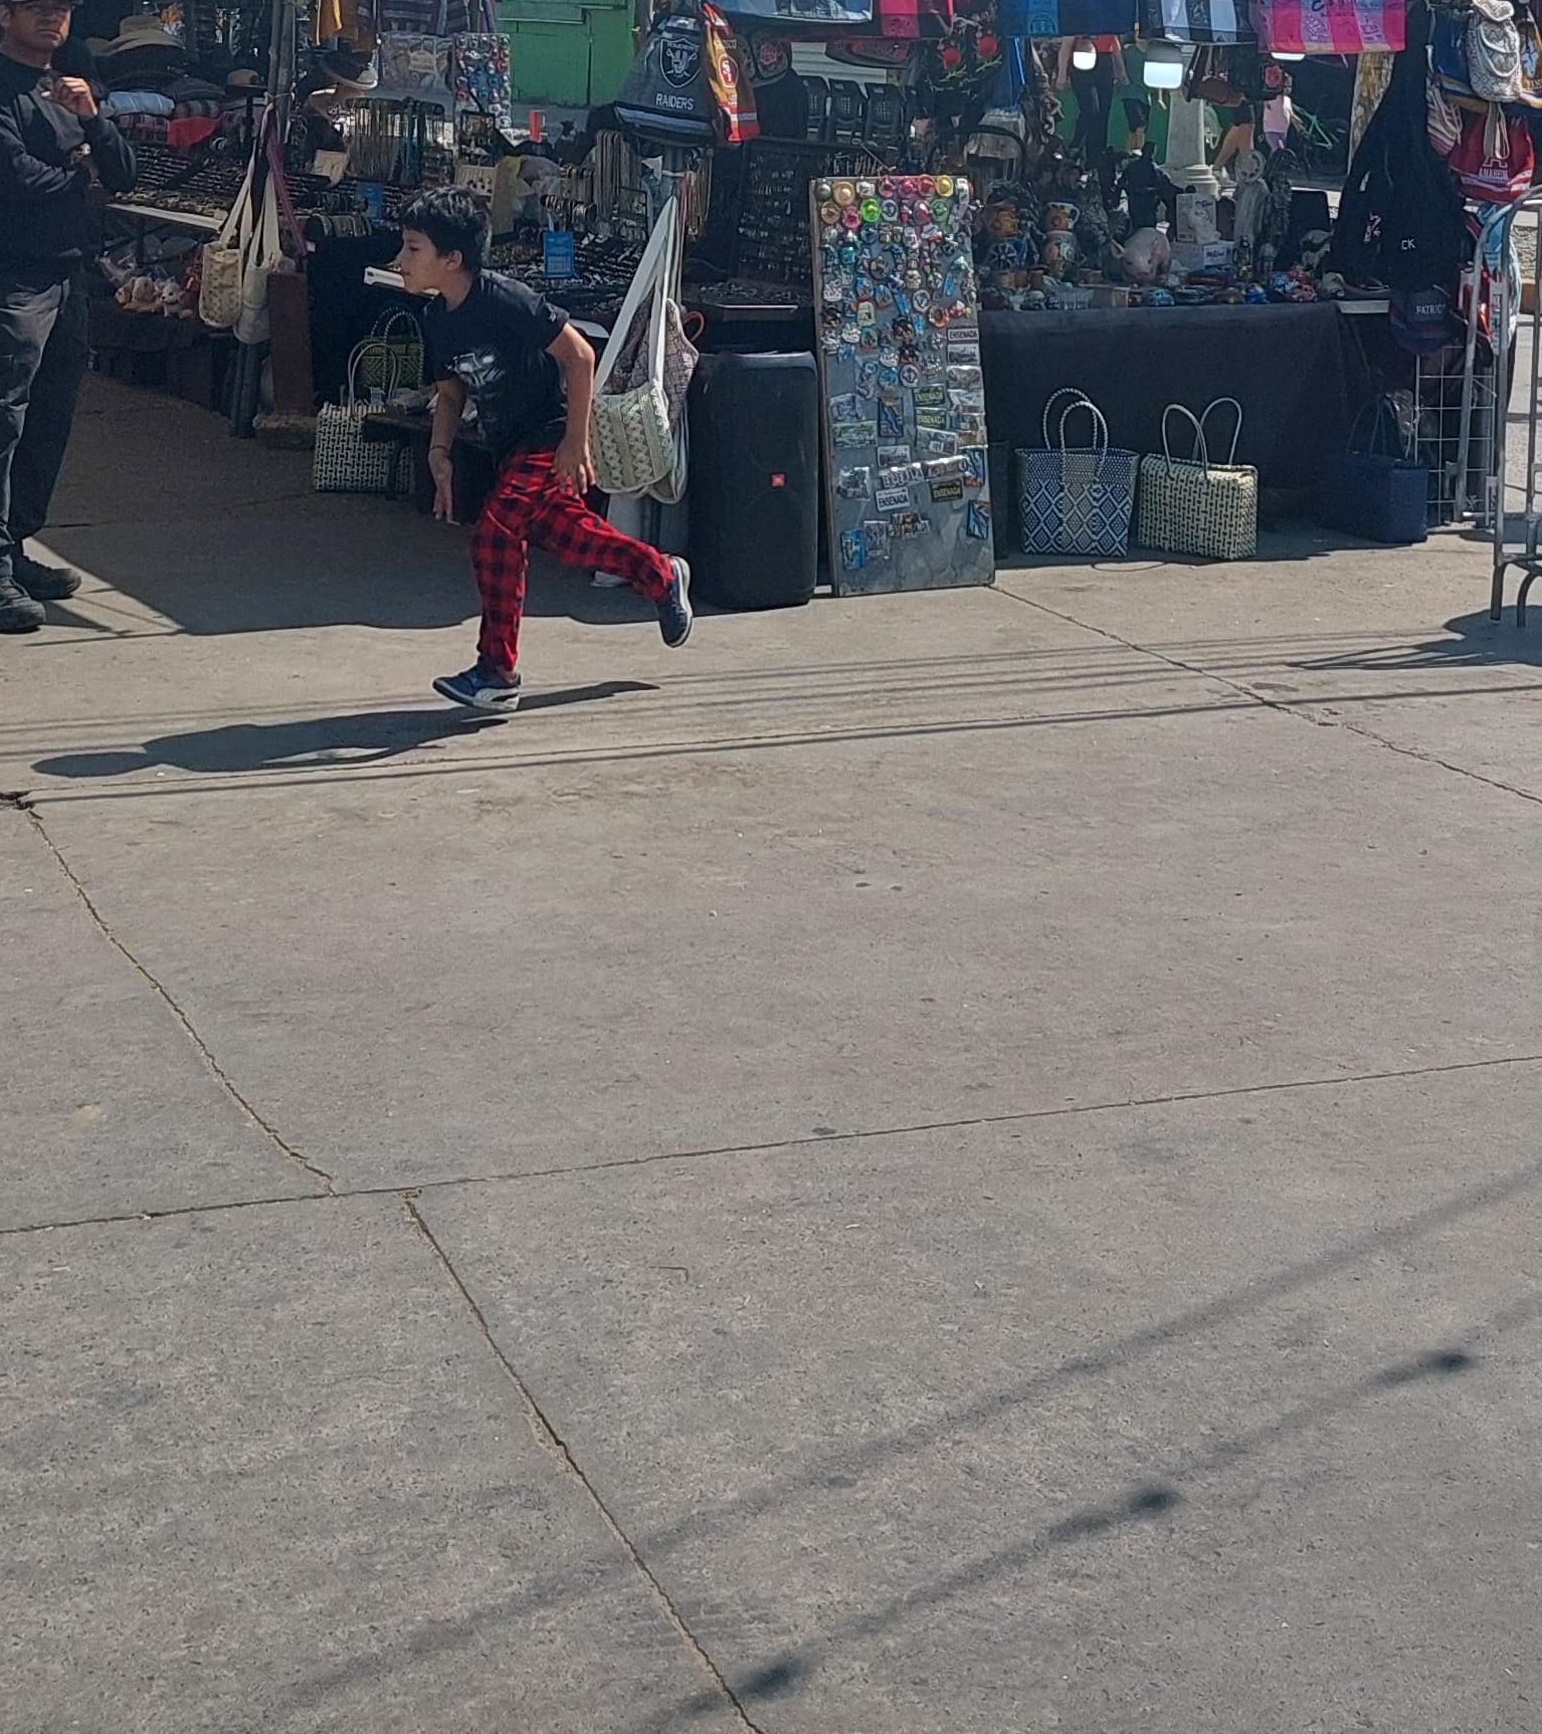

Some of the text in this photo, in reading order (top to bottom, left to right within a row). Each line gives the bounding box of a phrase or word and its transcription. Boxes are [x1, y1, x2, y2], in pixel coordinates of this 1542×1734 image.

[655, 93, 695, 111] RAIDERS
[1401, 239, 1416, 251] CK
[879, 494, 908, 508] ENSENADA
